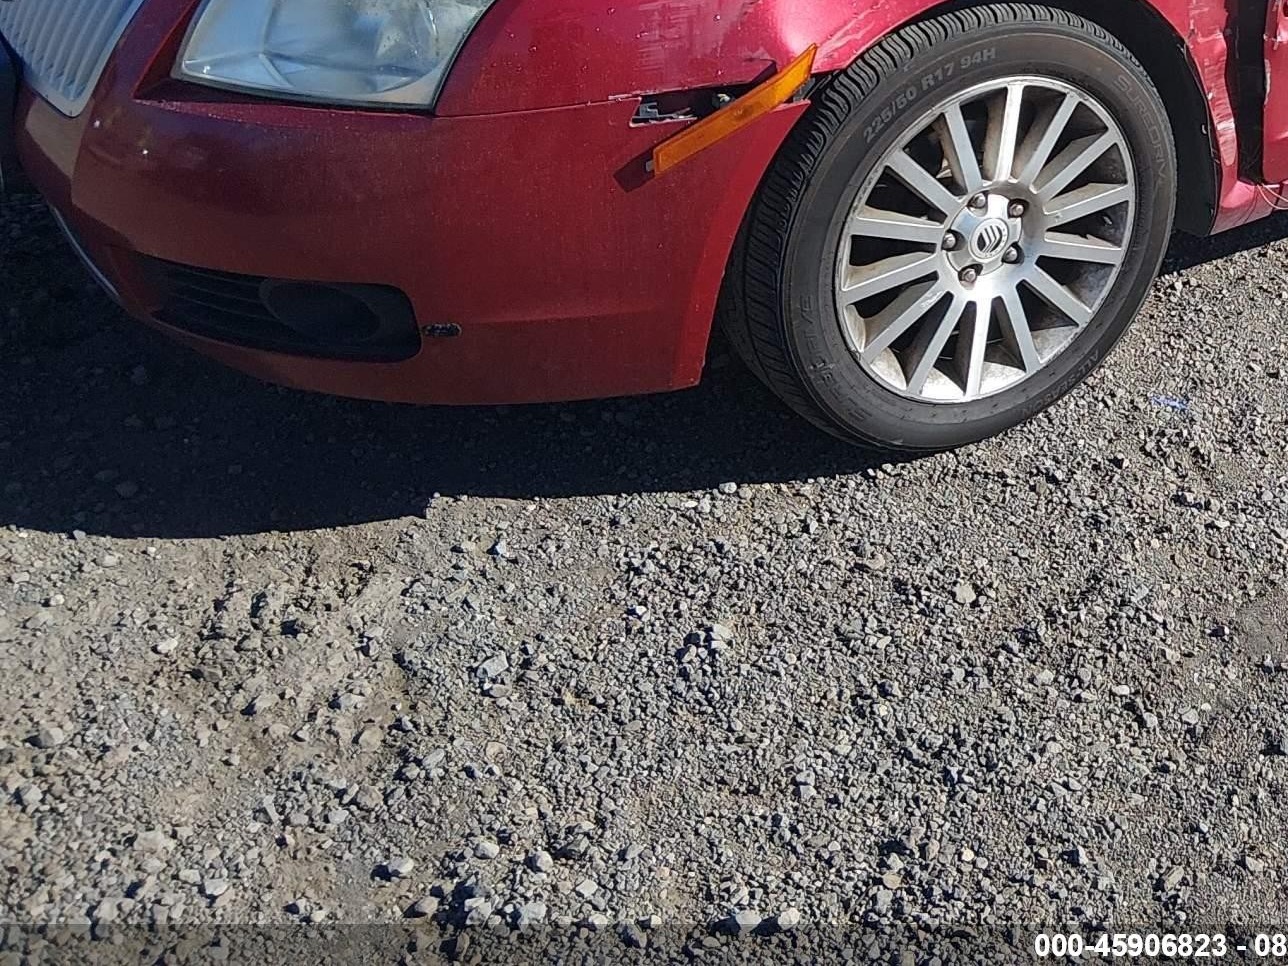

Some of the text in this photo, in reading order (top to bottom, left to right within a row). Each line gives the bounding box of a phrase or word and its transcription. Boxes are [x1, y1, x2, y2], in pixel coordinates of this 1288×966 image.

[863, 47, 997, 144] 225/50 R17 94H
